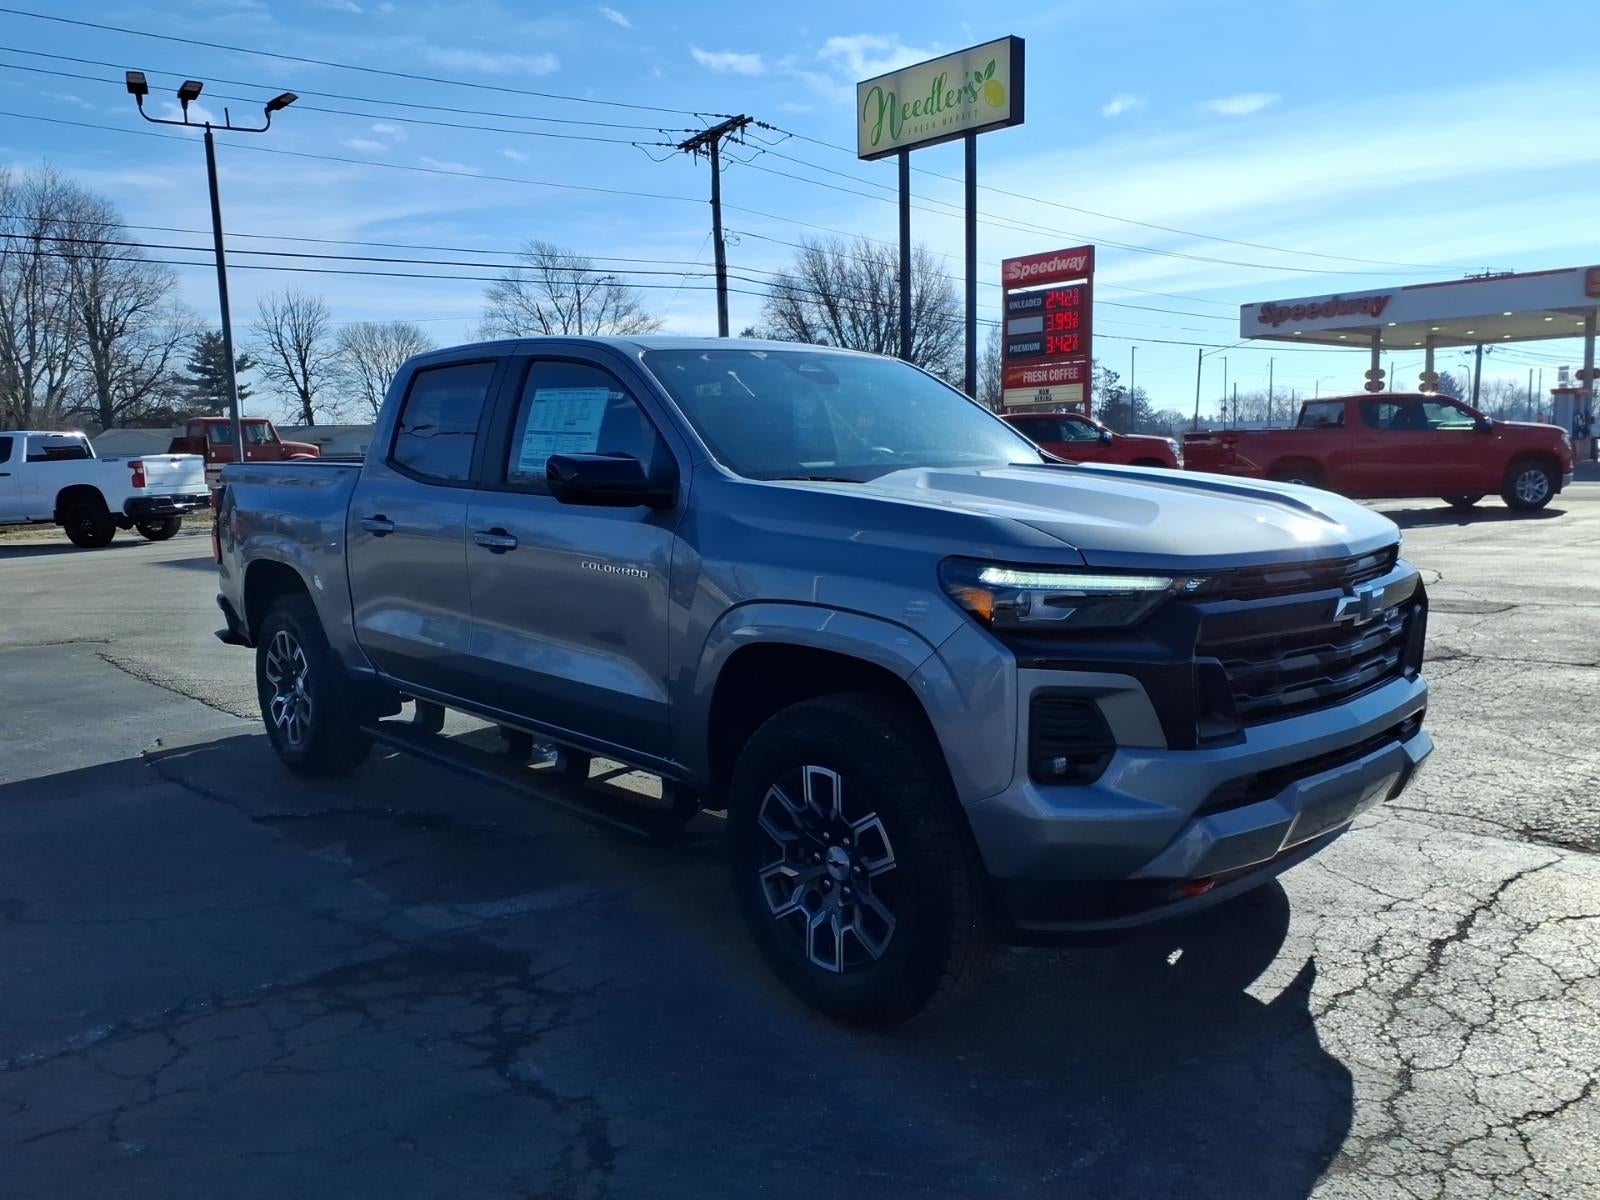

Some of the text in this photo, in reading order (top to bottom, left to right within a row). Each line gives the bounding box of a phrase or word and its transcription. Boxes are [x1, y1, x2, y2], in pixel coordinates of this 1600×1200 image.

[863, 71, 979, 147] Needler's
[1008, 255, 1087, 280] Speedway
[1009, 298, 1042, 310] UNLEADED
[1258, 295, 1392, 328] Speedway
[1009, 342, 1040, 353] PREMIUM
[1023, 367, 1078, 383] FRESH COFFEE
[581, 561, 649, 579] COLORADO
